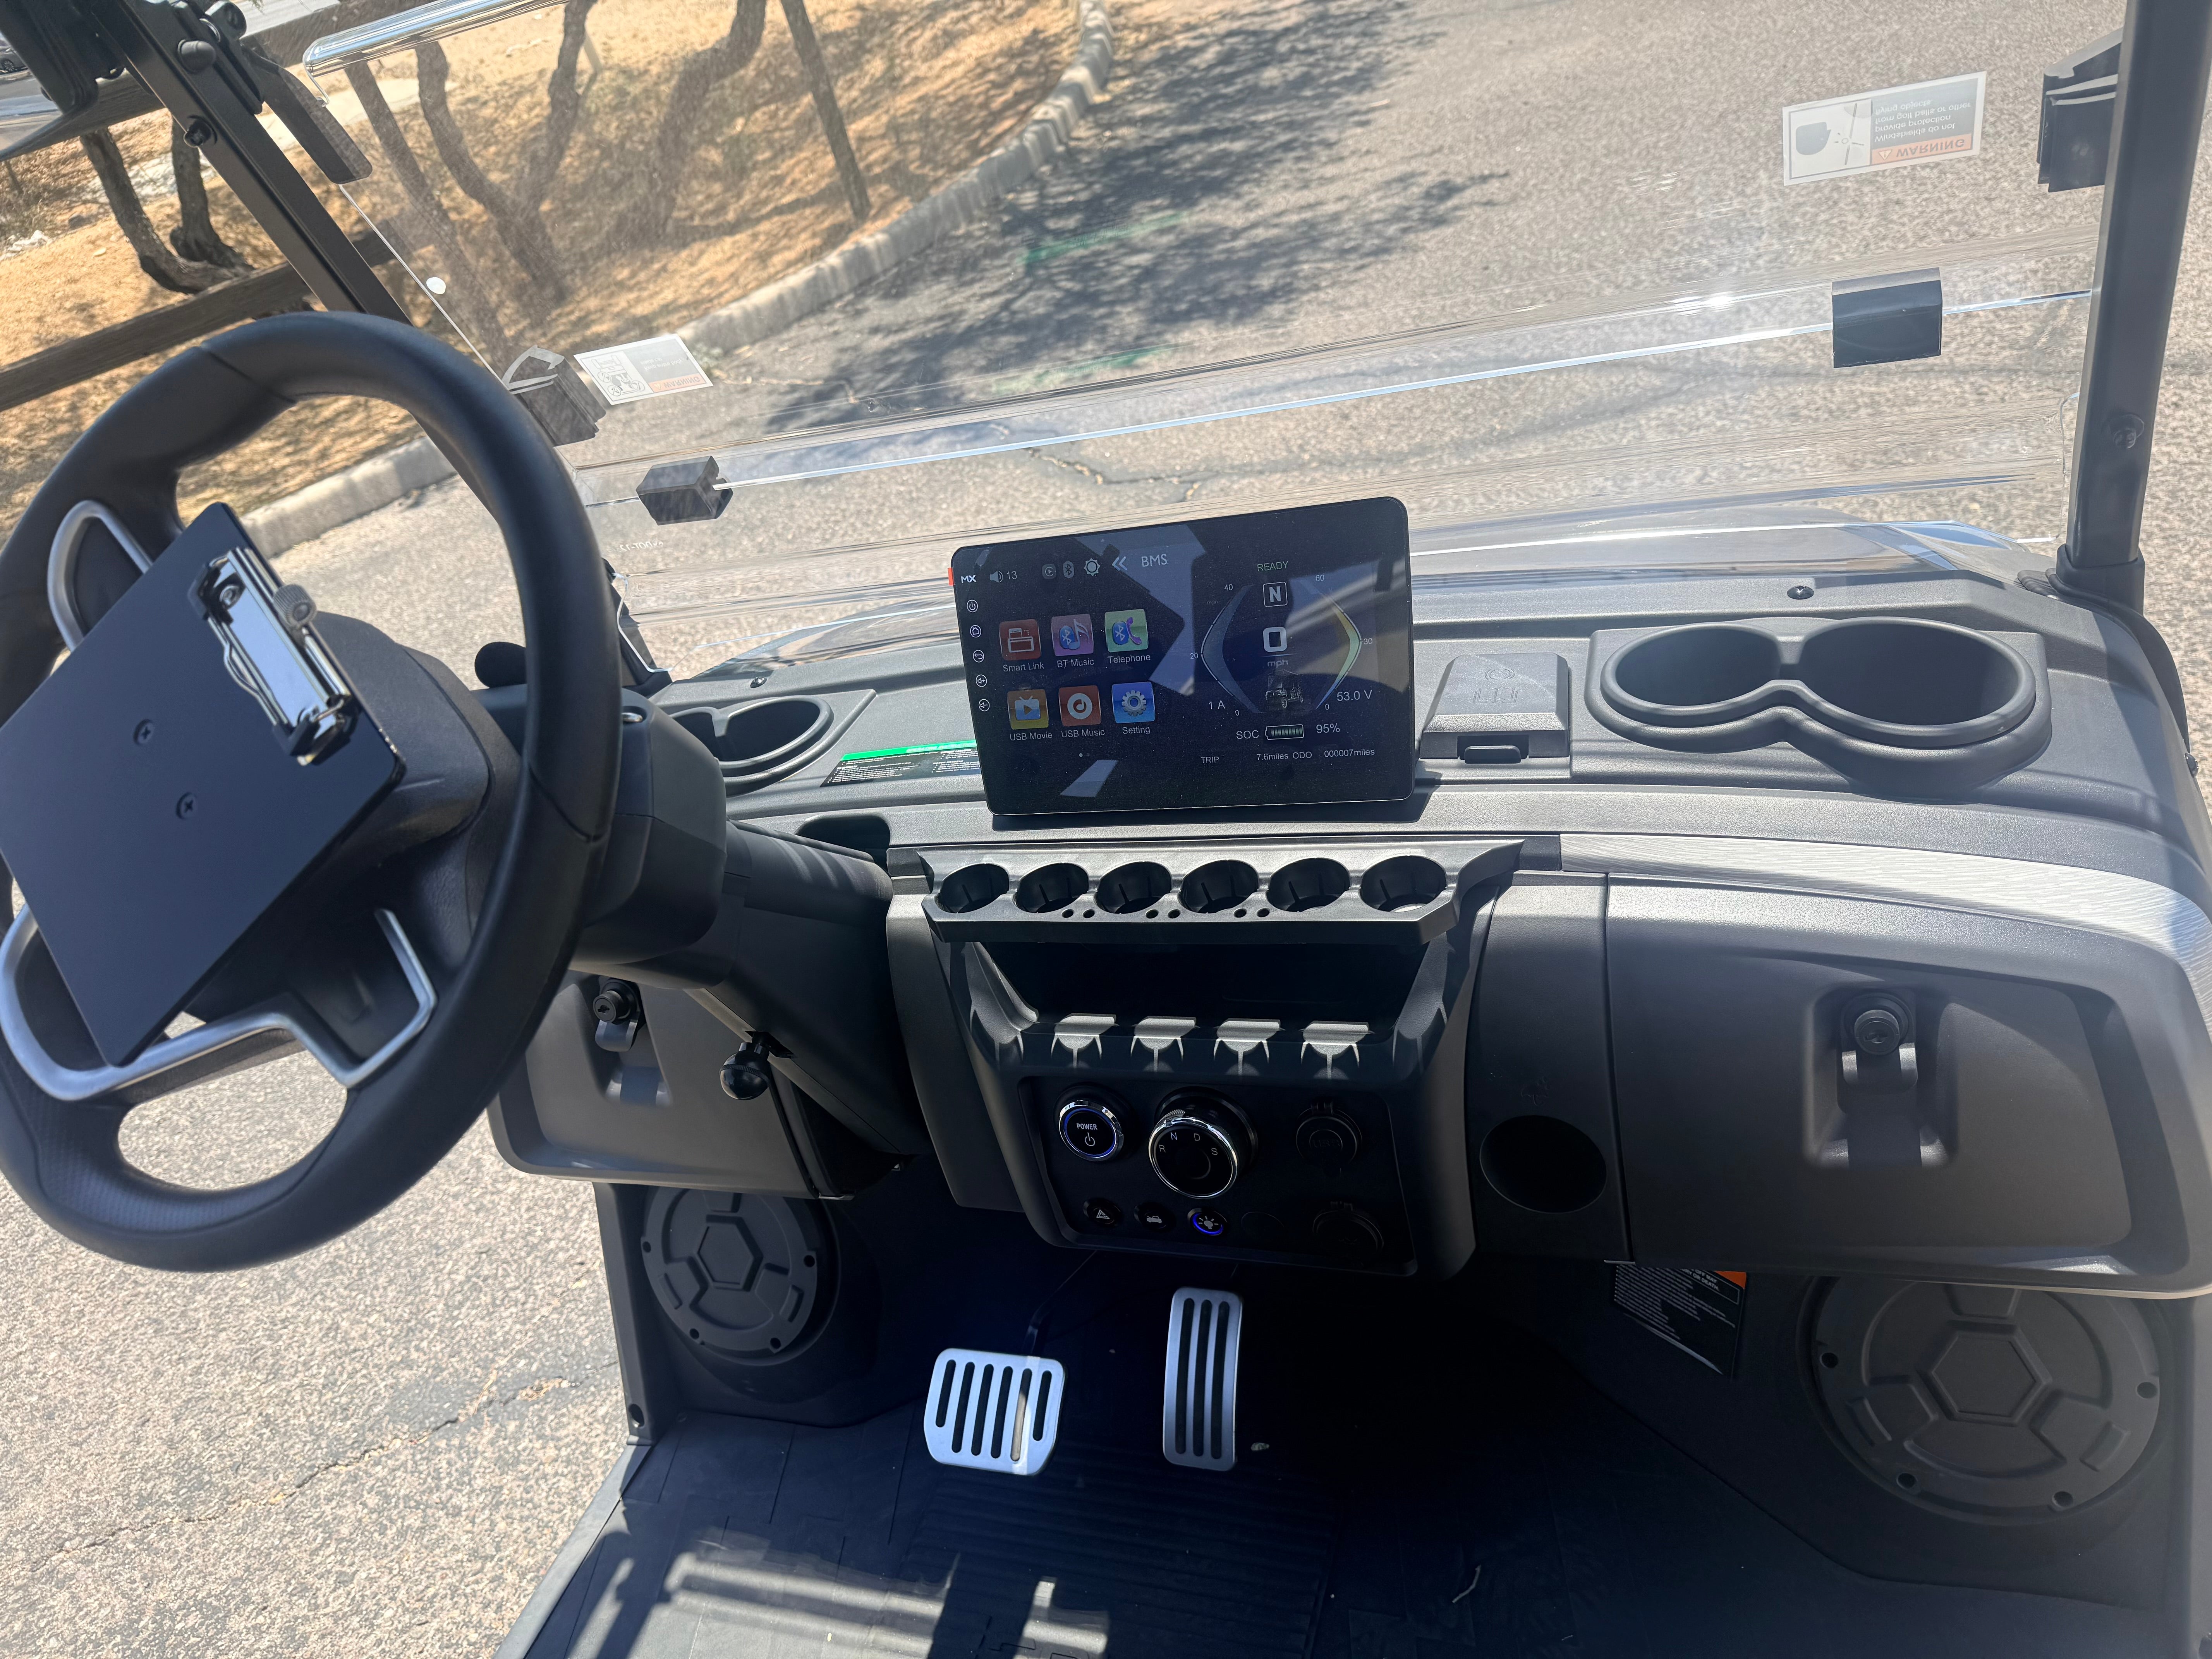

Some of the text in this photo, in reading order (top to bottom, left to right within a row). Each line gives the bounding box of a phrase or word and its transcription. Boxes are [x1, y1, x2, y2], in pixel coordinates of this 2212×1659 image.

[1141, 554, 1168, 567] BMS
[1257, 560, 1288, 572] READY
[1007, 570, 1017, 579] 13
[1269, 586, 1281, 603] N
[1057, 658, 1094, 668] BT Music
[1107, 654, 1151, 664] Telephone
[1267, 659, 1288, 668] mph
[1003, 662, 1044, 672] Smart Link
[1336, 690, 1372, 701] 53.0 V
[1208, 700, 1226, 709] 1 A
[1061, 728, 1105, 738] USB Music
[1122, 726, 1151, 735] Setting
[1316, 723, 1340, 733] 95%
[1010, 731, 1053, 741] USB Movie
[1236, 730, 1259, 739] SOC
[1170, 1132, 1178, 1140] N
[1194, 1133, 1200, 1141] D
[1159, 1144, 1166, 1152] R
[1211, 1147, 1218, 1156] S
